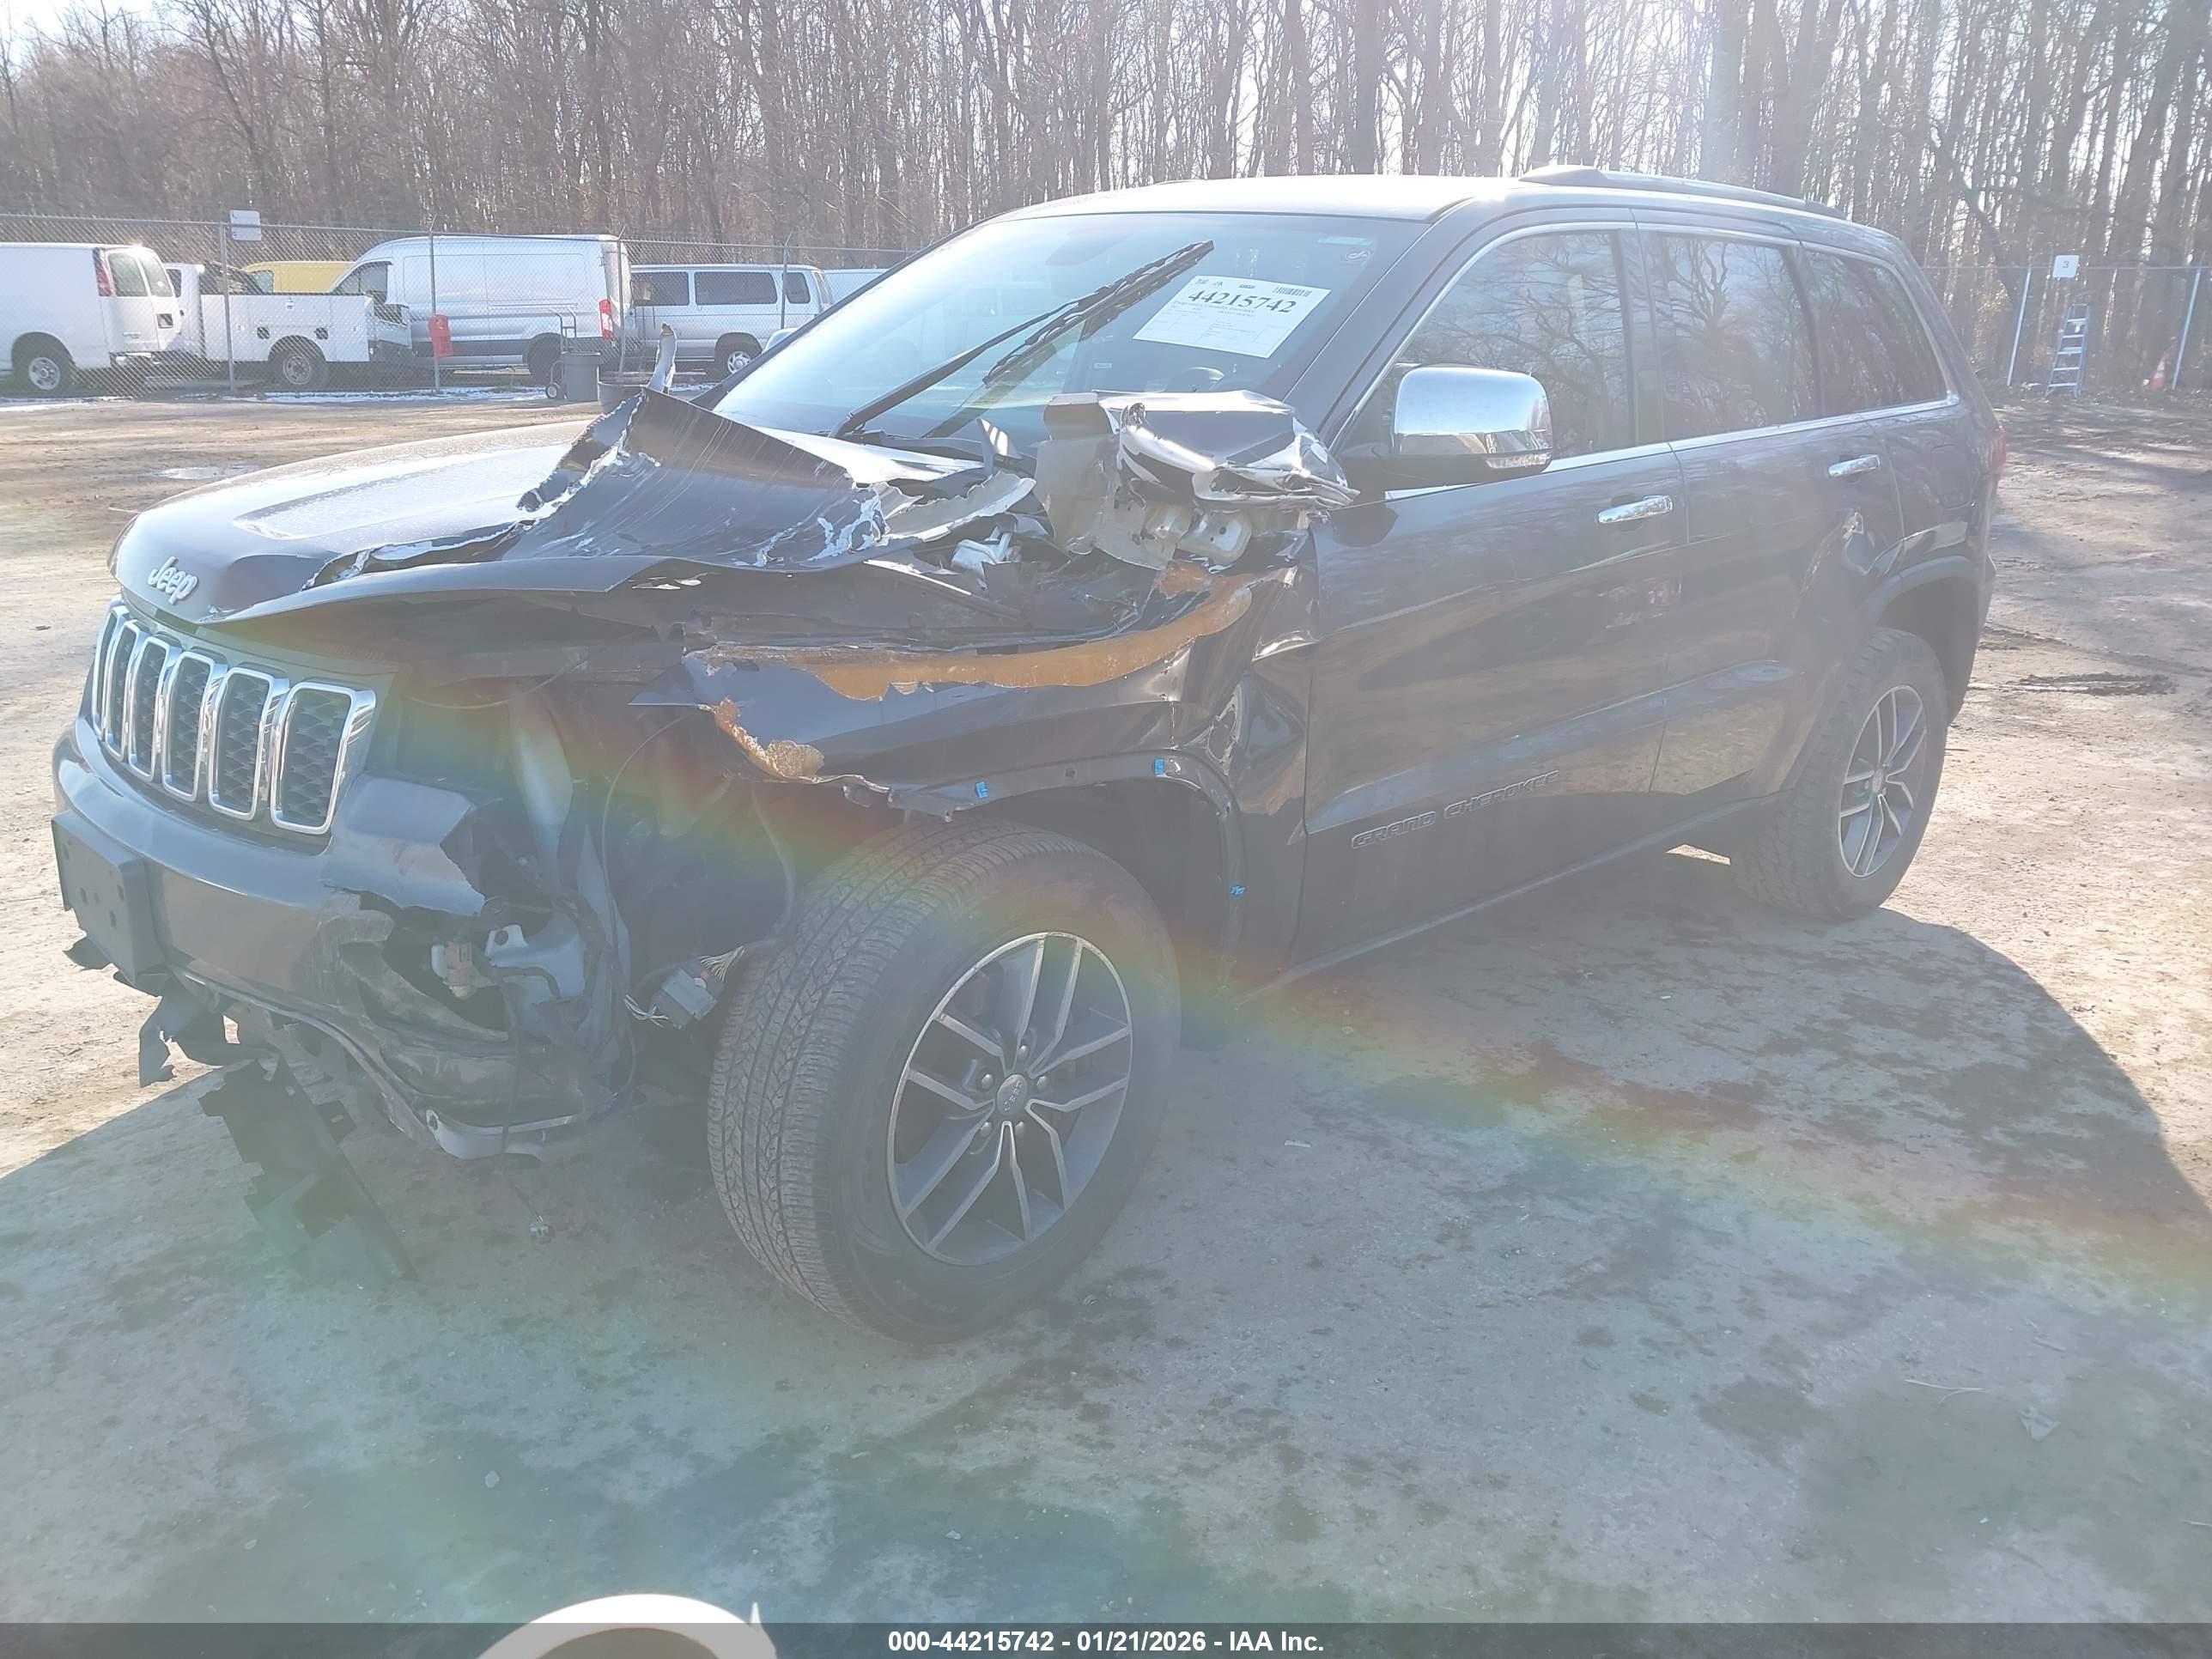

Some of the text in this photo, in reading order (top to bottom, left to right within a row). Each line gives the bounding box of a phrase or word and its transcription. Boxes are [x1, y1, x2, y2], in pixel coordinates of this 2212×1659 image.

[1188, 289, 1297, 313] 44215742
[148, 556, 198, 605] Jeep
[1352, 770, 1559, 848] GRAND CHEROKEE
